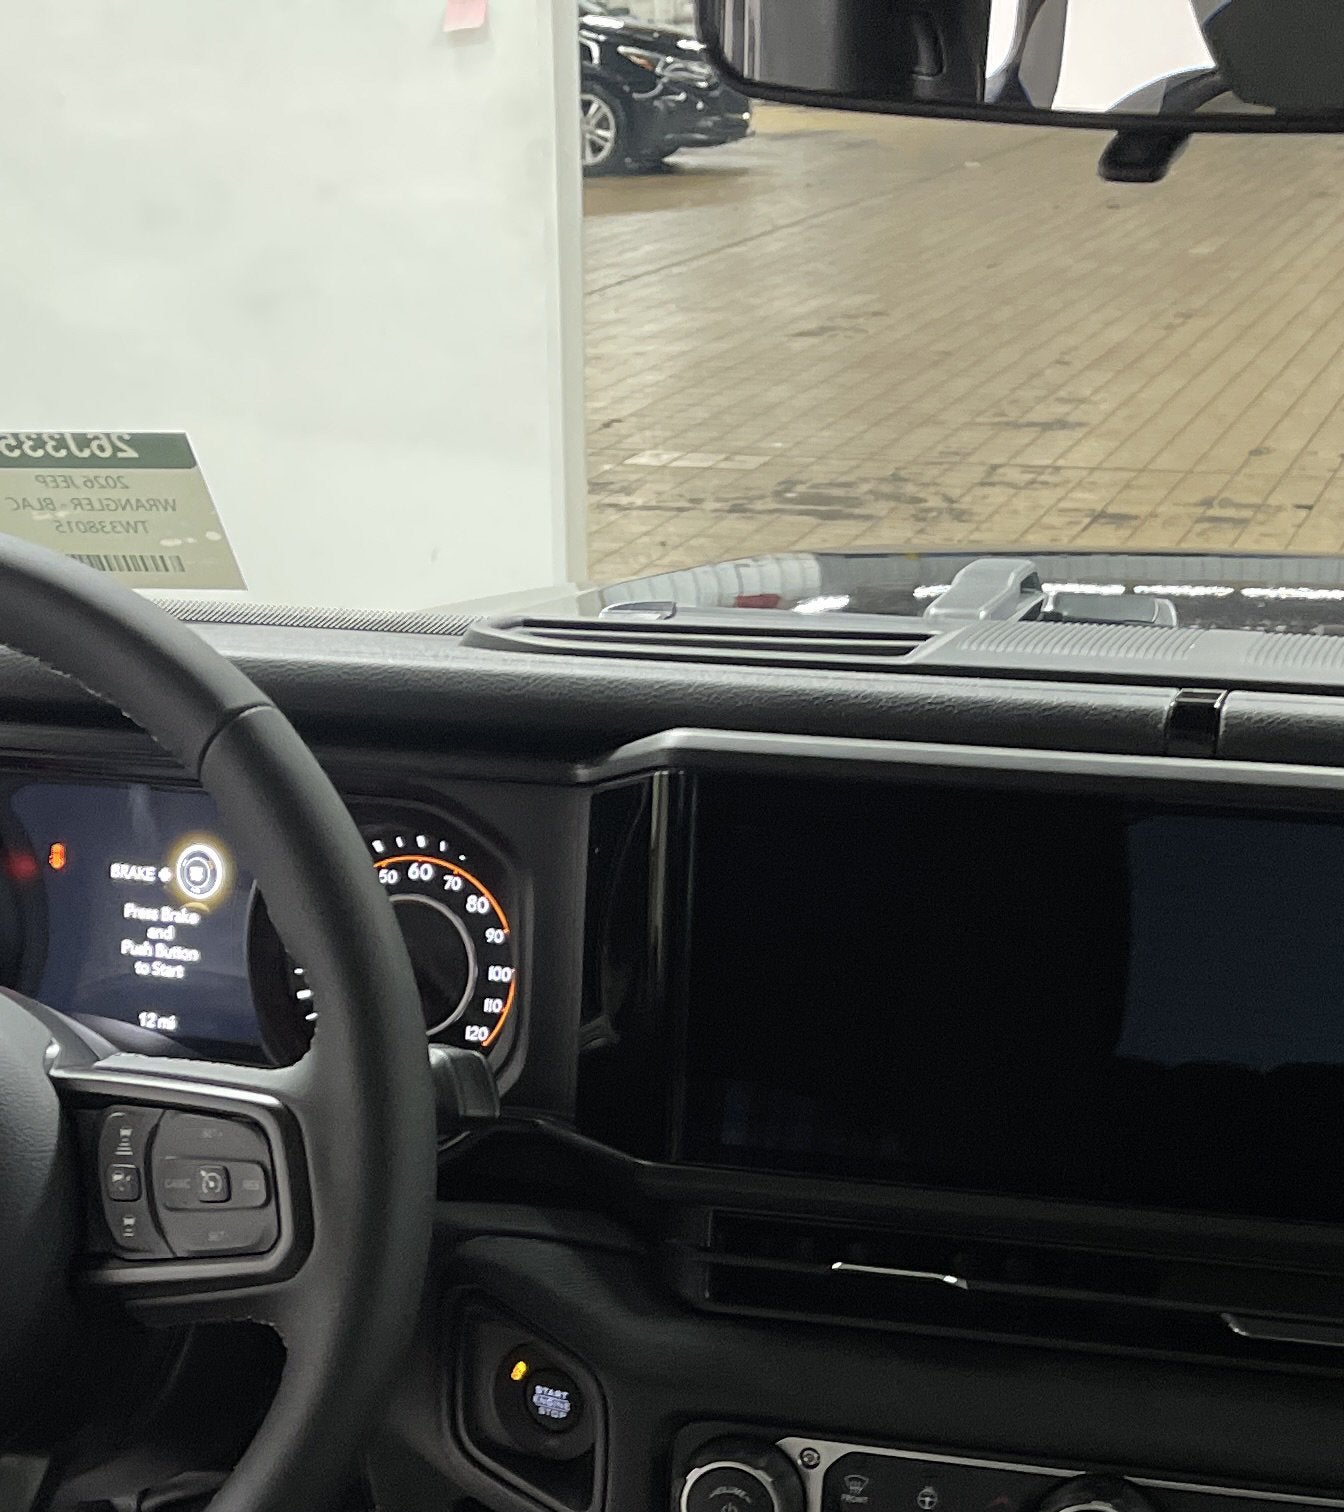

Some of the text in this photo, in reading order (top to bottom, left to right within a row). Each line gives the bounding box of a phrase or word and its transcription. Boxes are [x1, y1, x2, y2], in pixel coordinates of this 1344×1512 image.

[110, 863, 156, 881] BRAKE
[378, 869, 398, 884] 50
[407, 863, 434, 881] 60
[443, 874, 463, 891] 70
[465, 894, 490, 914] 80
[146, 925, 176, 940] and
[485, 927, 505, 944] 90
[488, 965, 513, 982] 100
[483, 998, 503, 1013] 110
[465, 1025, 489, 1041] 120
